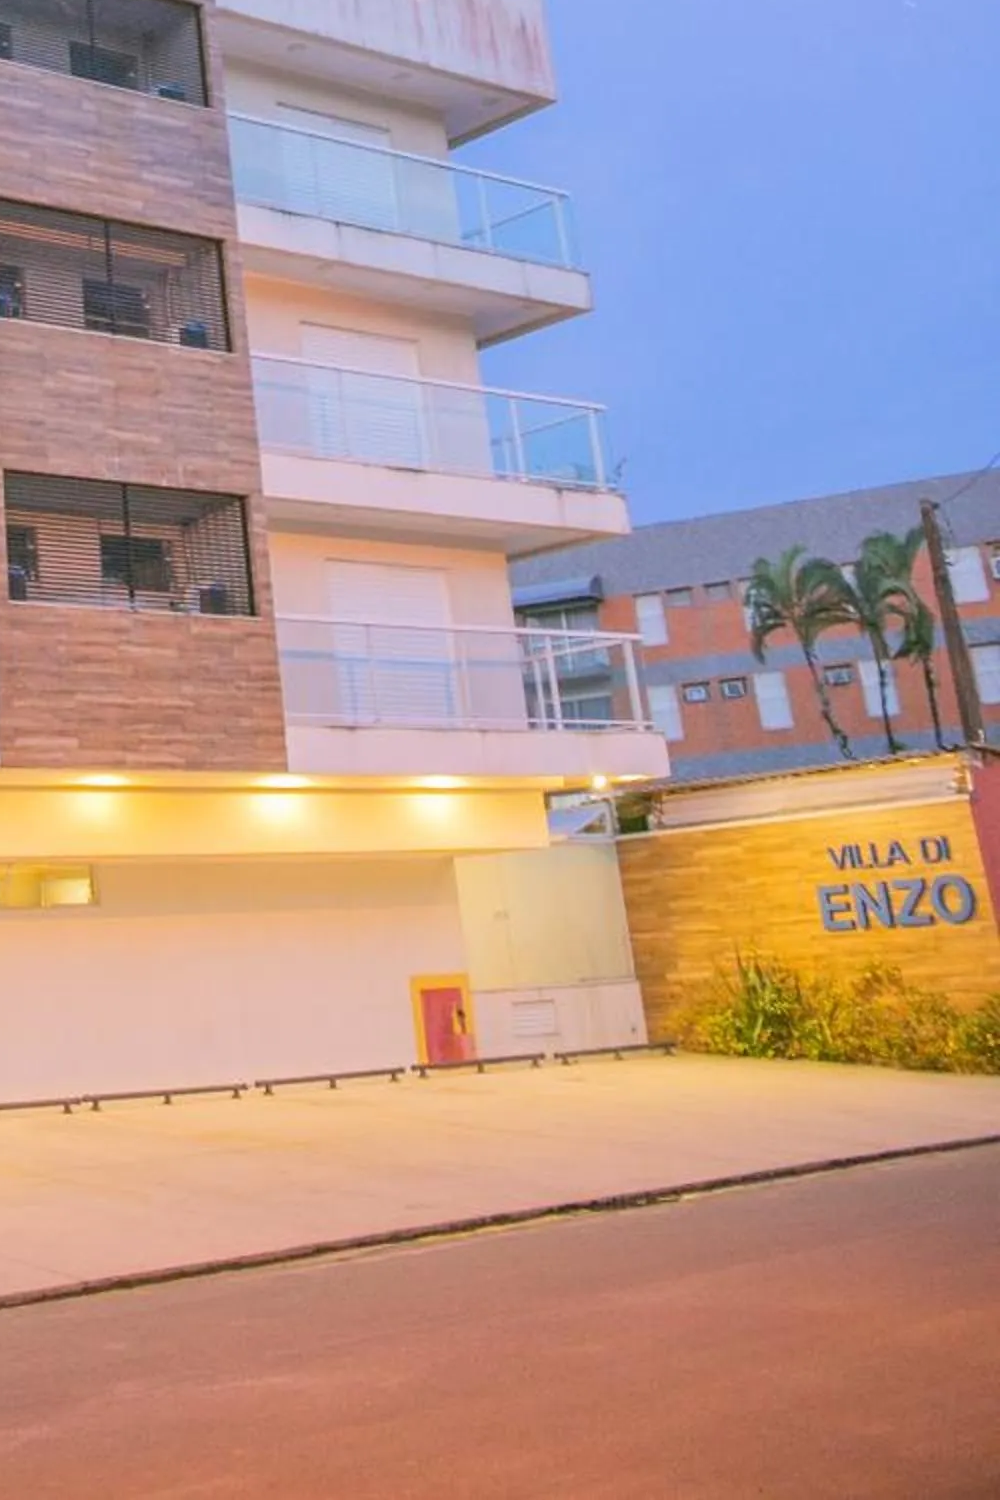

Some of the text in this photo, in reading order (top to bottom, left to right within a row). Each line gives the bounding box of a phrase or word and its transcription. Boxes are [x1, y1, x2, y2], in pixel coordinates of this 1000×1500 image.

[827, 836, 952, 870] VILLA DI
[817, 874, 977, 932] ENZO
